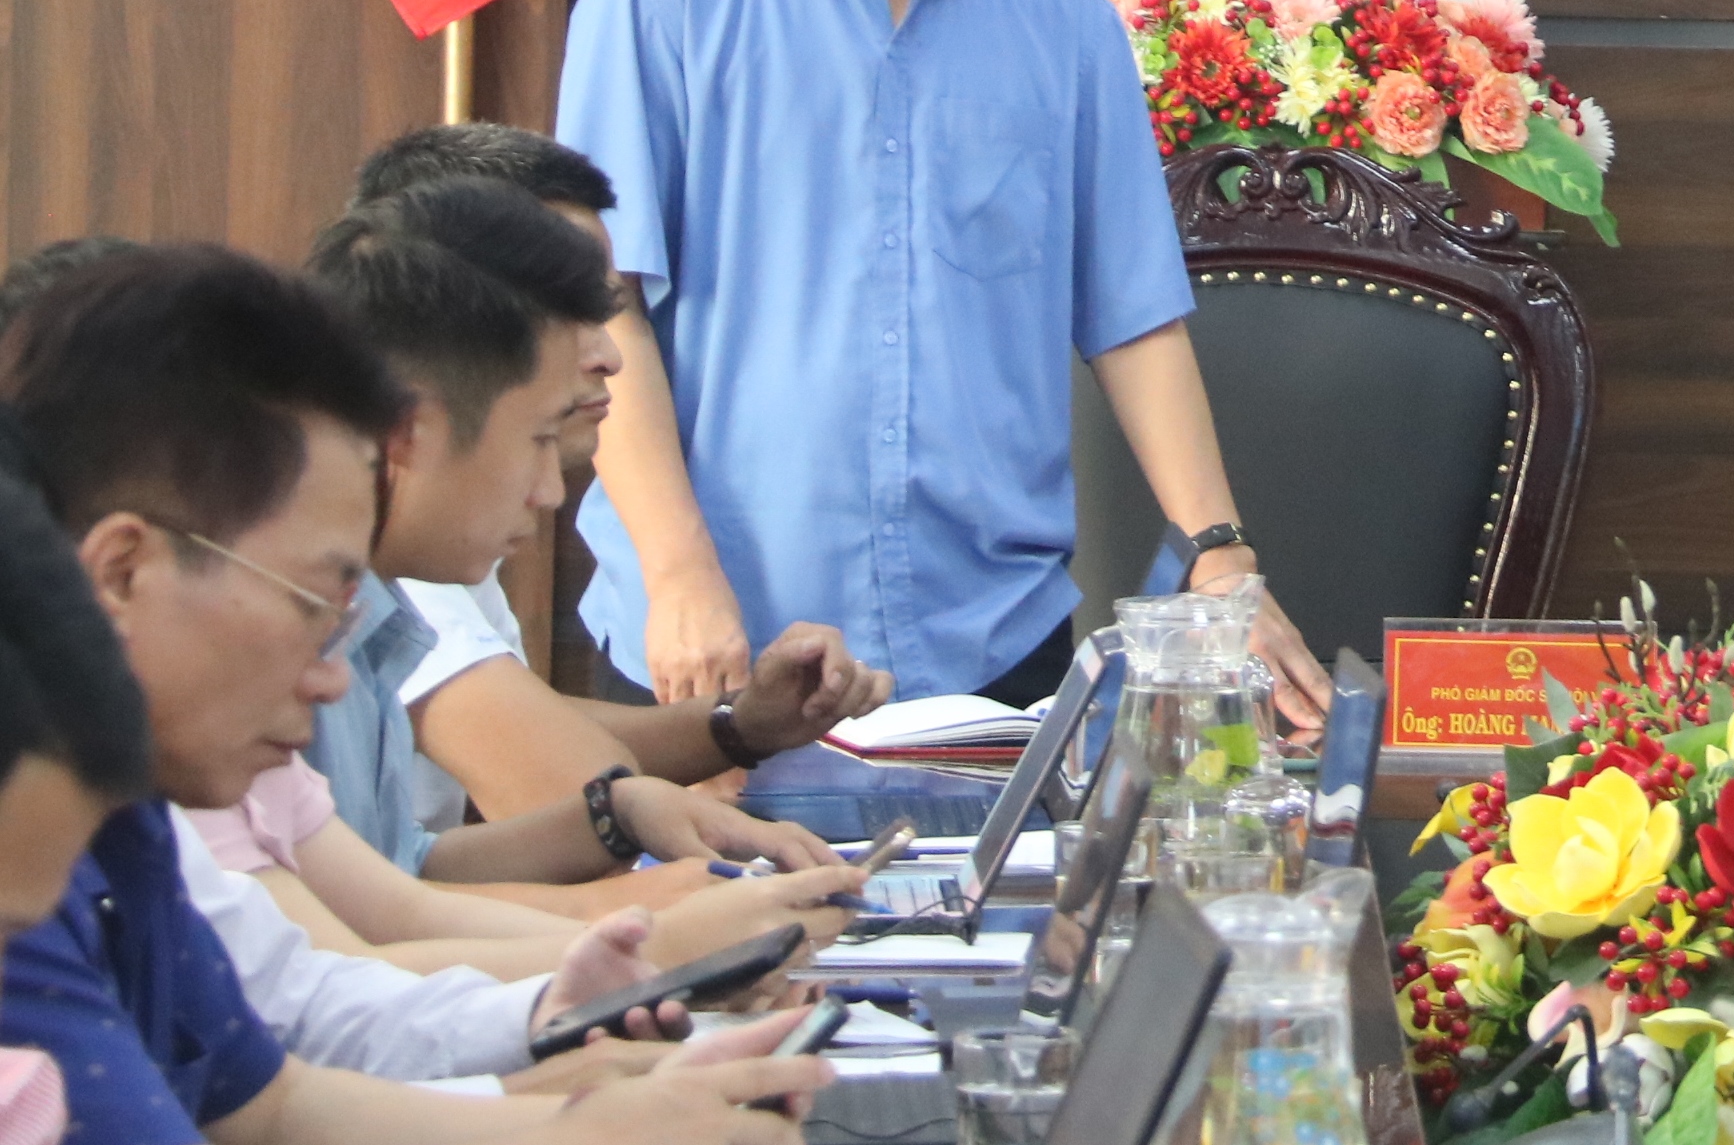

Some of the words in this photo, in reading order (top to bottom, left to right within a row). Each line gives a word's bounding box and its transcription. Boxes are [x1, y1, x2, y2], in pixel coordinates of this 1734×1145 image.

[1504, 685, 1535, 702] ĐỐC
[1402, 706, 1443, 739] Ông:
[1449, 708, 1516, 735] HOÀNG
